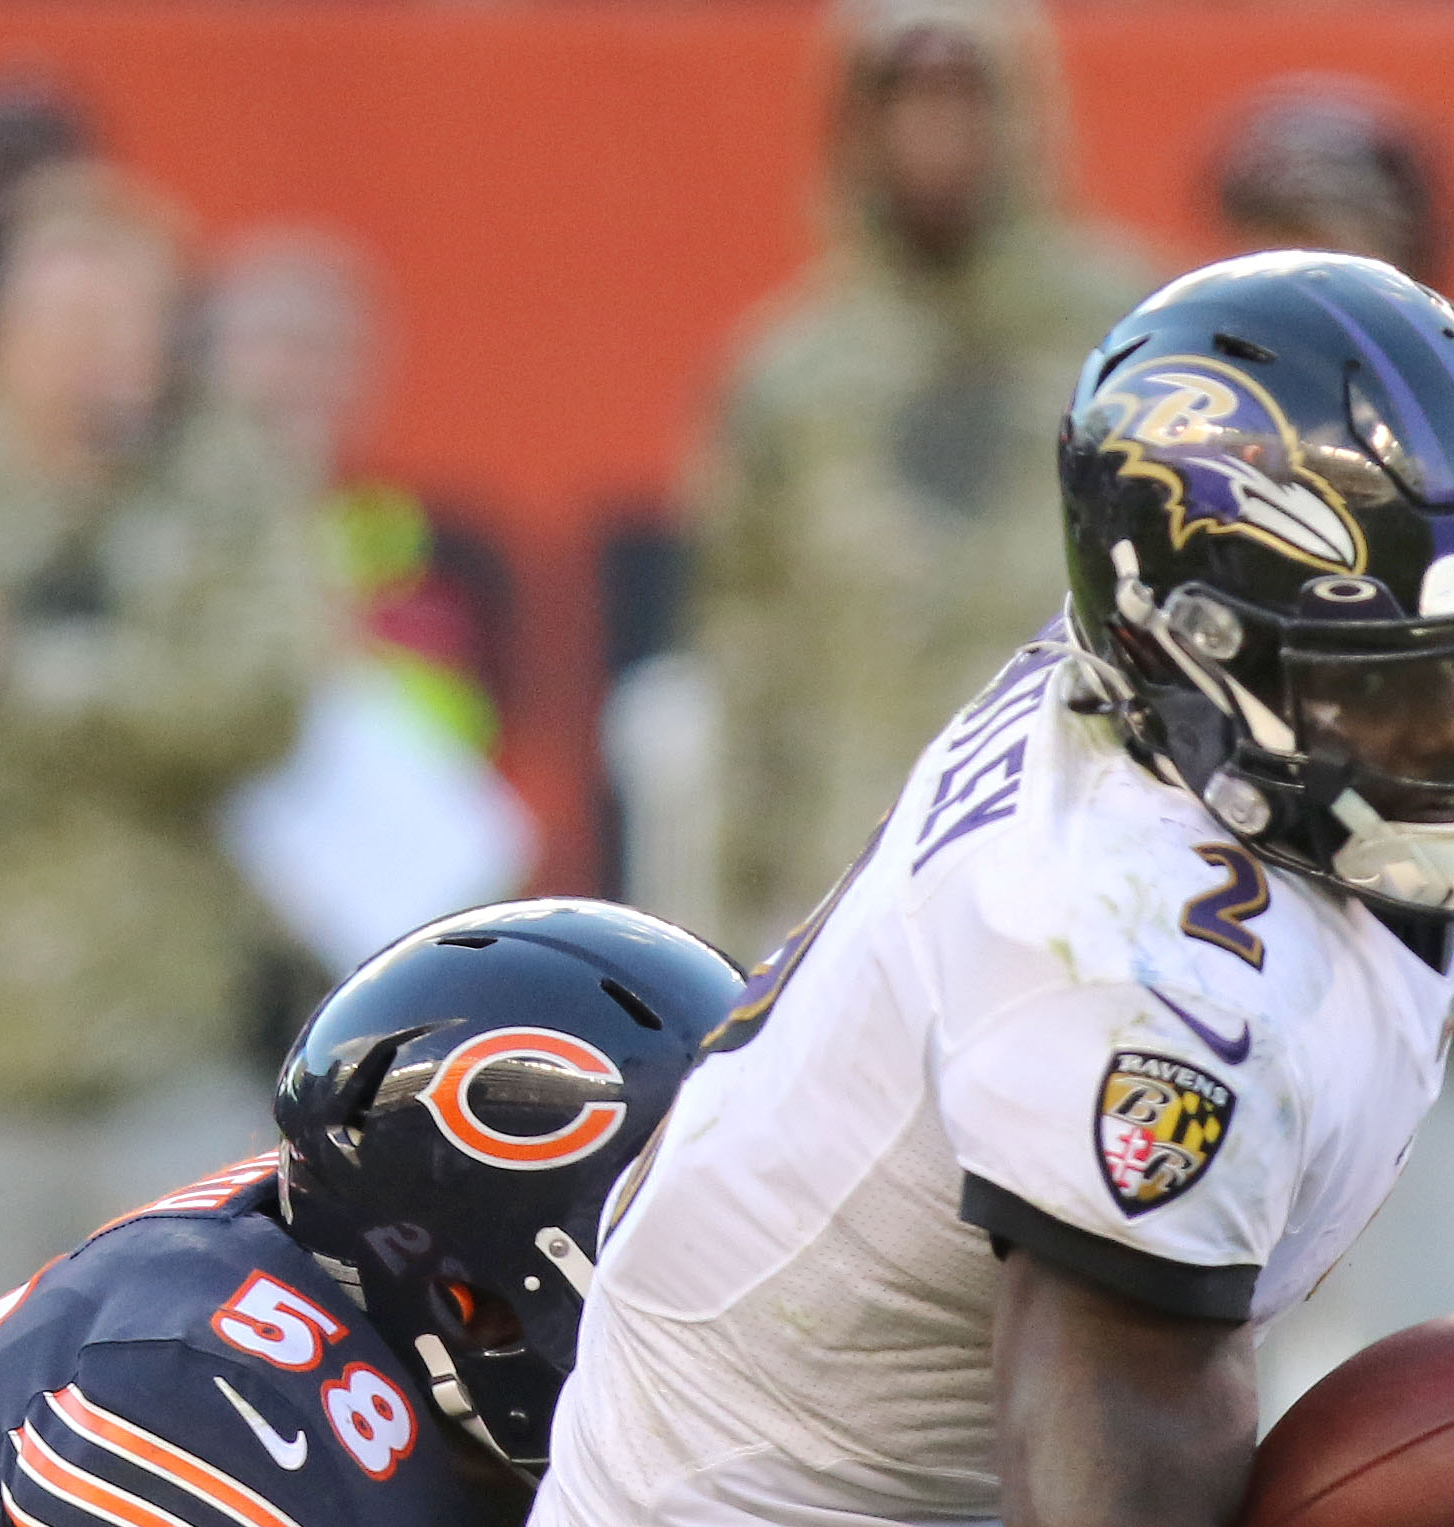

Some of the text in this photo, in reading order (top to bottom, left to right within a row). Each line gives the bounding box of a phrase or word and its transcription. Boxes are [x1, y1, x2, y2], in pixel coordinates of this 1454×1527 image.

[1180, 841, 1271, 973] 2
[1116, 1053, 1230, 1108] RAVENS
[211, 1268, 419, 1482] 58
